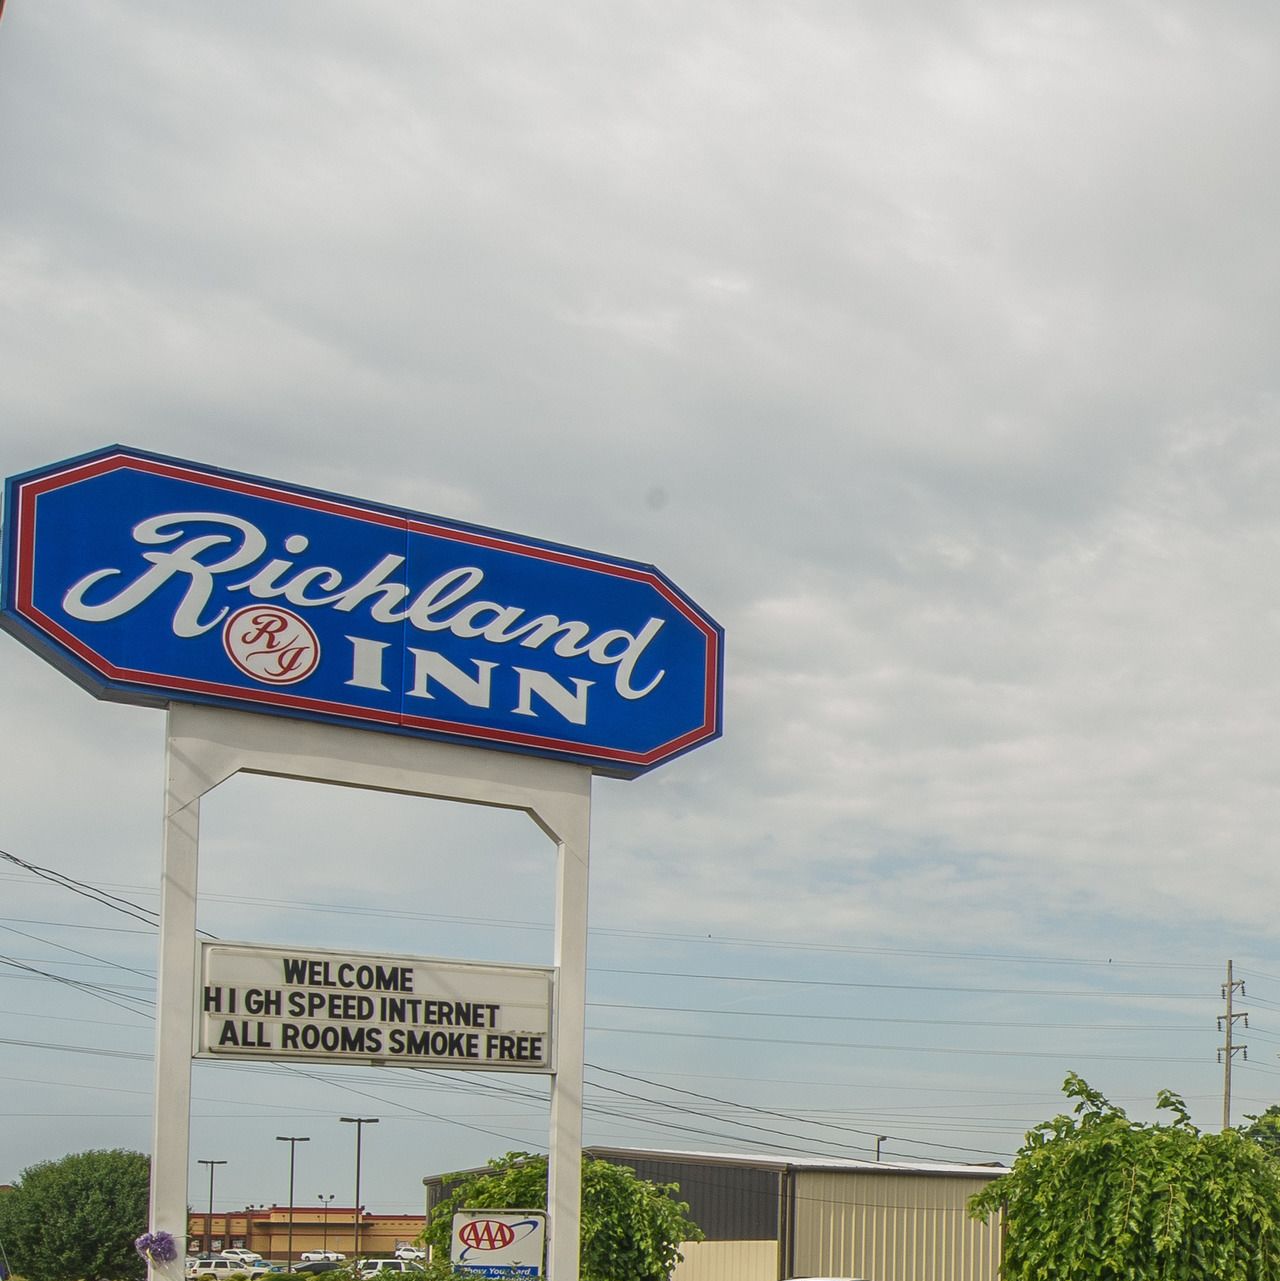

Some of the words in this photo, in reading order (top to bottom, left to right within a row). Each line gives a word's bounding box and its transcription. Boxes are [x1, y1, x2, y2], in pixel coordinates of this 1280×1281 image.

[62, 511, 666, 700] Richland
[343, 634, 597, 726] INN
[283, 958, 414, 993] WELCOME
[288, 991, 375, 1021] SPEED
[380, 997, 500, 1029] INTERNET
[218, 1020, 271, 1048] ALL
[282, 1023, 383, 1053] ROOMS
[388, 1028, 480, 1059] SMOKE
[486, 1034, 543, 1061] FREE
[464, 1220, 510, 1250] AAA
[489, 1267, 508, 1275] You
